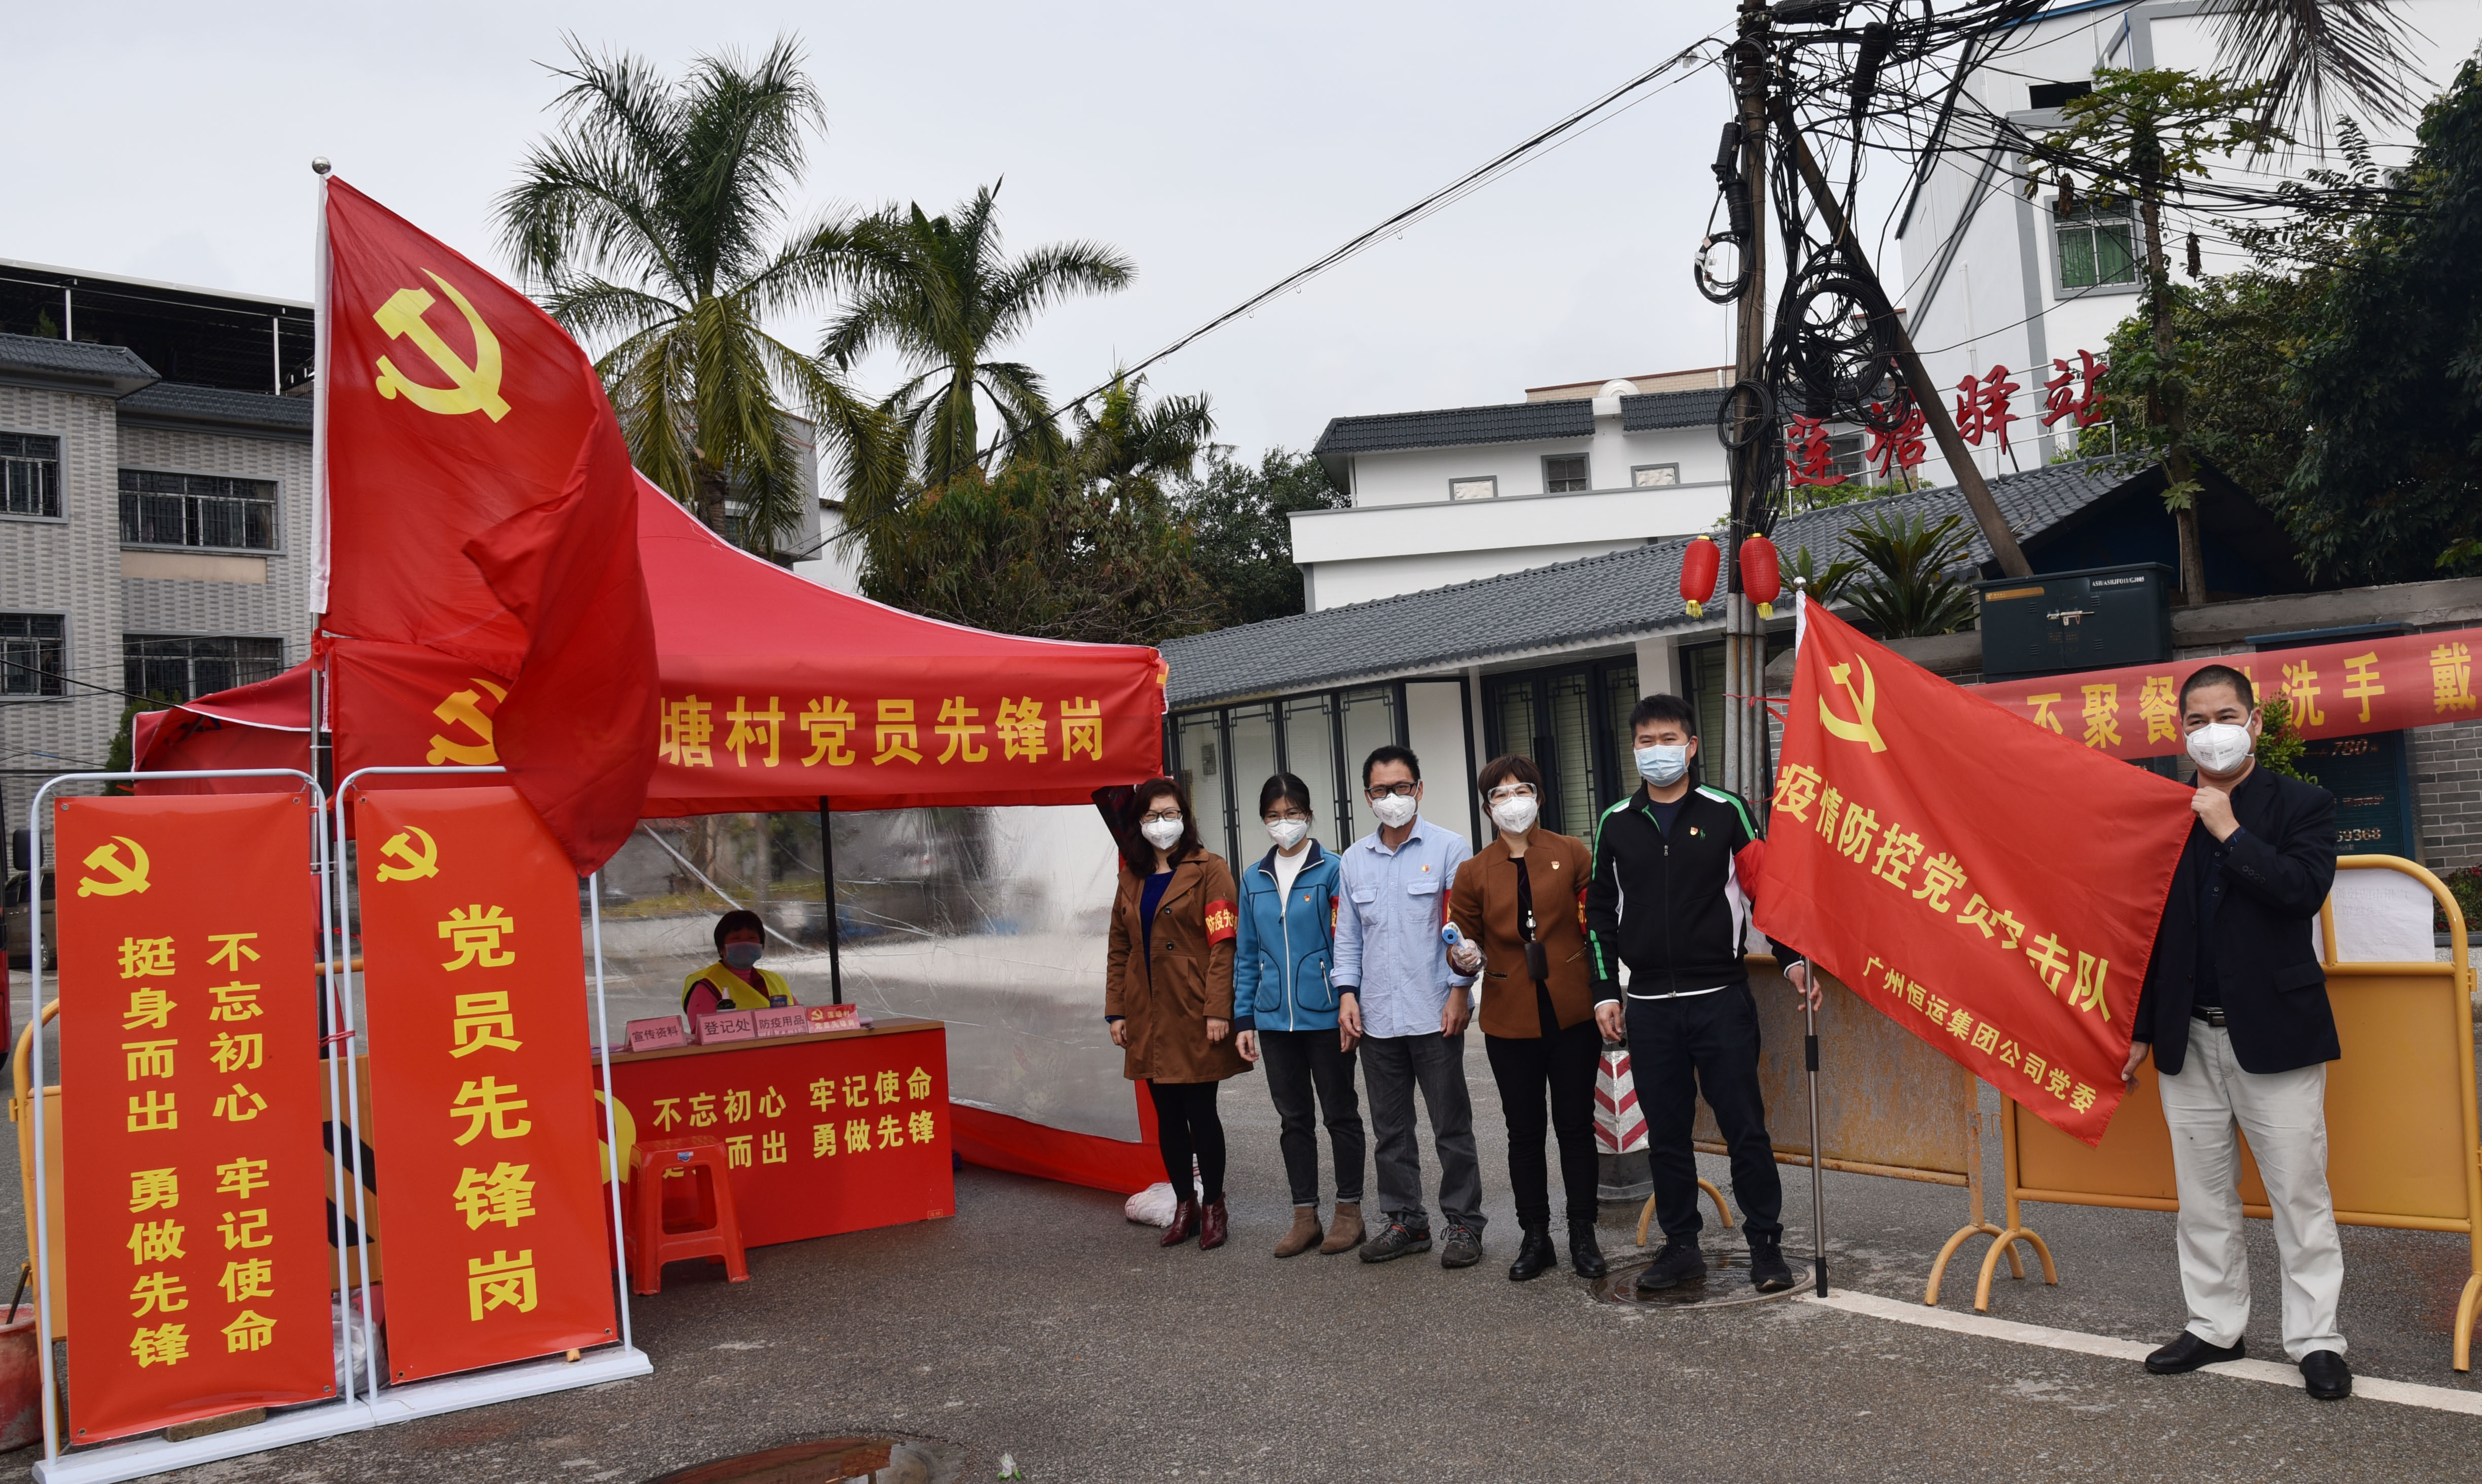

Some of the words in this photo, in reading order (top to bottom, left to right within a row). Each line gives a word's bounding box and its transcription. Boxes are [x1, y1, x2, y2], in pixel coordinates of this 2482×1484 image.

[2429, 642, 2476, 714] 戴
[659, 694, 1103, 767] 塘村党员先锋岗
[117, 936, 178, 1133] 挺身而出
[206, 932, 268, 1123] 不忘初心
[632, 1025, 679, 1043] 宣传资料
[704, 1018, 751, 1036] 登记处
[759, 1015, 805, 1030] 防疫用品
[1862, 956, 2098, 1115] 广州恒运集团公司党委
[437, 904, 538, 1322] 党员先锋岗
[653, 1085, 787, 1133] 不忘初心
[810, 1066, 932, 1113] 牢记使命
[813, 1109, 935, 1159] 勇做先锋
[126, 1167, 190, 1369] 勇做先锋
[216, 1157, 277, 1354] 牢记使命
